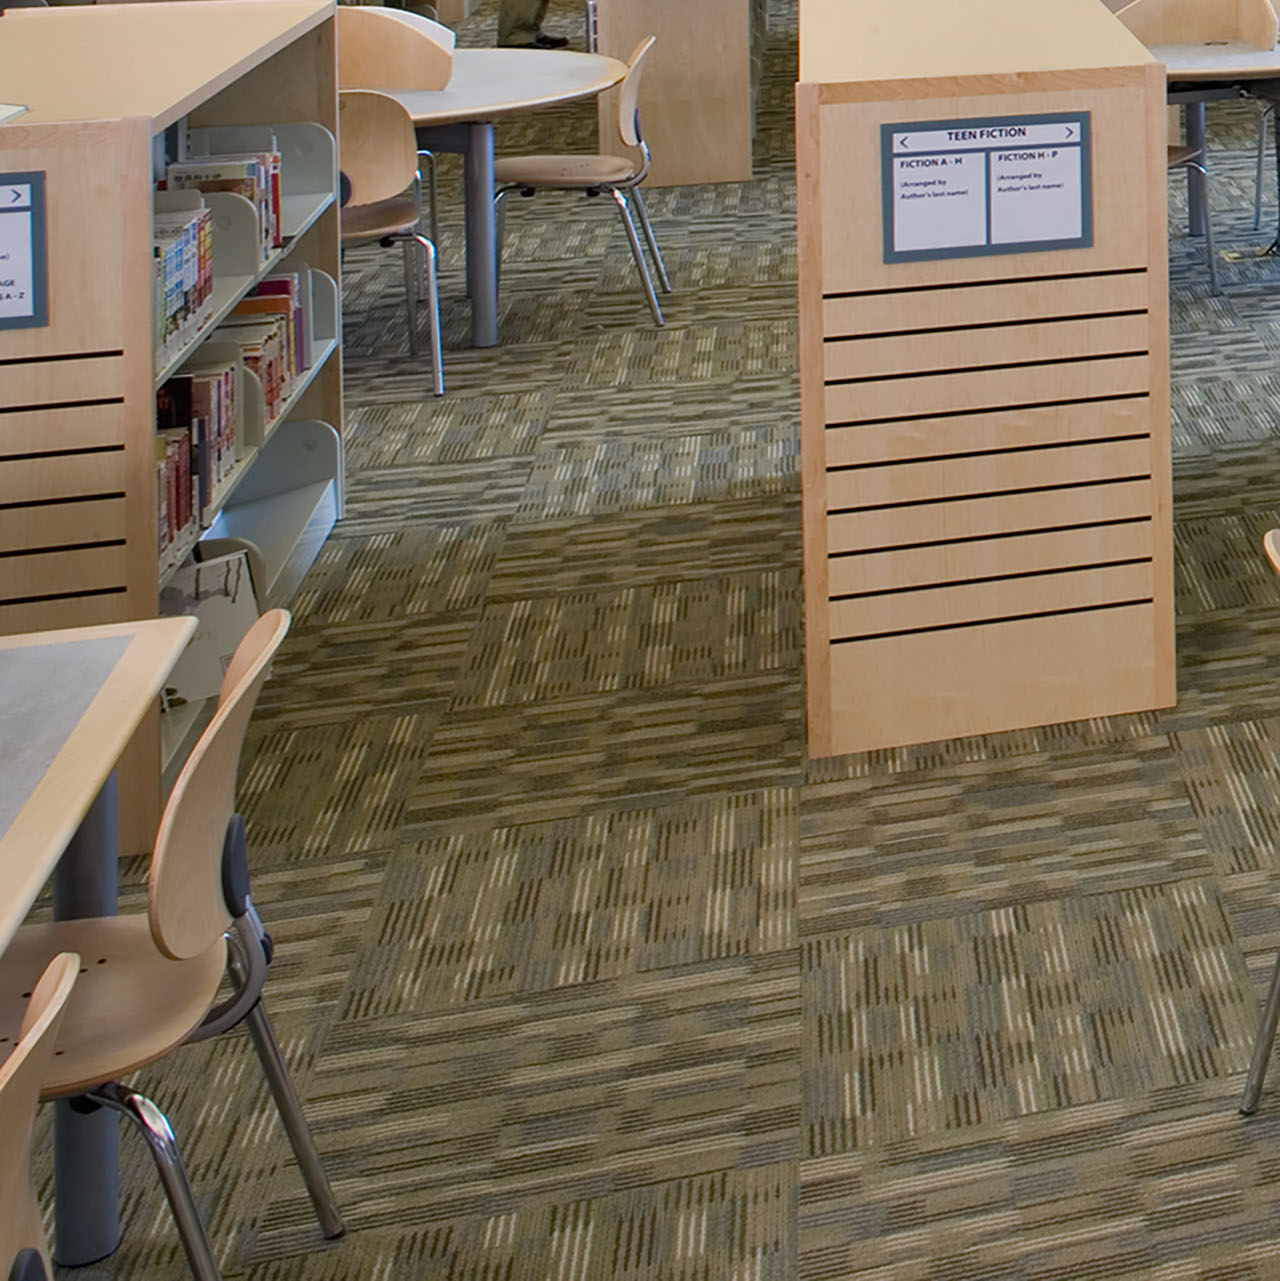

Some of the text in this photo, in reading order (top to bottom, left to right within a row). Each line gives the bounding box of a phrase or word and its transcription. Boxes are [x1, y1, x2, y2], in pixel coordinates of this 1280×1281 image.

[946, 127, 1026, 142] TEEN FICTION
[998, 152, 1036, 162] FICTION
[1037, 152, 1045, 160] H
[1052, 150, 1058, 158] P
[900, 158, 939, 169] FICTION
[940, 158, 948, 166] A
[955, 157, 962, 165] H
[1034, 172, 1042, 180] by
[938, 178, 946, 186] by
[18, 292, 25, 300] Z
